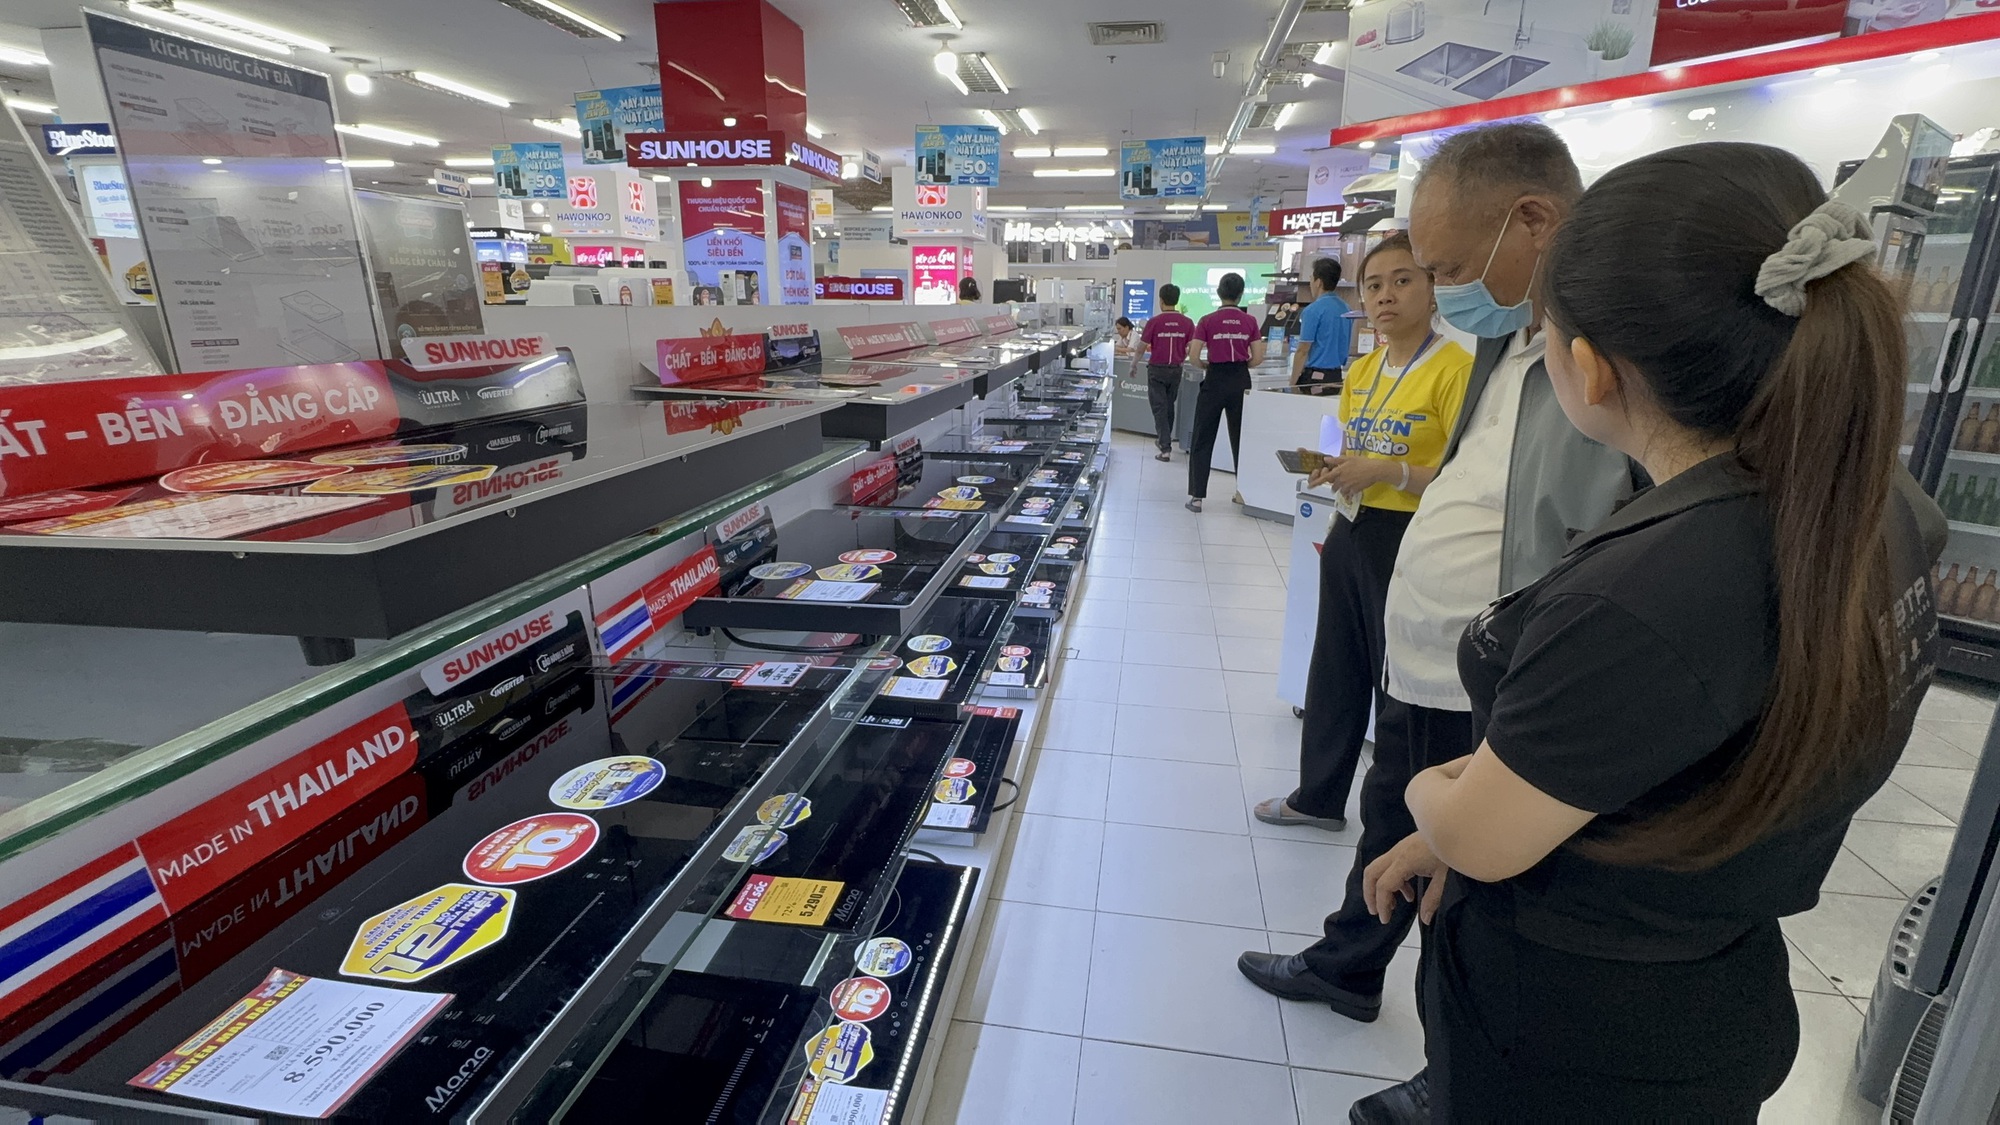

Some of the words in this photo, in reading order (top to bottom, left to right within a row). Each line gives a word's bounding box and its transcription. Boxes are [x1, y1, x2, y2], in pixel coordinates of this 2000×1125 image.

[149, 37, 190, 62] KÍCH
[191, 49, 243, 75] THƯỚC
[244, 60, 271, 82] CẮT
[273, 69, 293, 87] ĐÁ
[640, 140, 771, 160] SUNHOUSE
[791, 141, 839, 177] SUNHOUSE
[557, 213, 611, 222] HAWONKOO
[901, 211, 963, 220] HAWONKOO
[724, 236, 743, 246] KHỐI
[1004, 221, 1104, 243] Hisense
[707, 247, 725, 257] SIÊU
[773, 323, 809, 337] SUNHOUSE
[424, 336, 542, 365] SUNHOUSE
[664, 347, 692, 370] CHẤT
[700, 346, 717, 366] BỀN
[724, 341, 746, 363] ĐẲNG
[747, 341, 762, 359] CẤP
[420, 390, 460, 406] ULTRA
[481, 388, 513, 399] INVERTER
[99, 398, 183, 447] BỀN
[219, 383, 319, 432] ĐẲNG
[324, 379, 380, 416] CẤP
[1372, 415, 1412, 437] LỚN
[723, 505, 760, 538] SUNHOUSE
[648, 598, 668, 616] MADE
[665, 592, 675, 604] IN
[670, 555, 716, 599] THAILAND
[443, 613, 553, 683] SUNHOUSE
[494, 674, 525, 698] INVERTER
[436, 699, 475, 726] ULTRA
[158, 833, 229, 885] MADE
[233, 819, 254, 844] IN
[248, 726, 406, 828] THAILAND
[479, 843, 511, 869] GIẢM
[450, 891, 500, 929] TRIỆU
[743, 897, 756, 912] GIÁ
[753, 881, 768, 898] SỐC
[363, 921, 413, 960] CHƯƠNG
[409, 895, 447, 922] TRÌNH
[370, 923, 461, 974] 12
[153, 1043, 218, 1090] KHUYẾN
[215, 1021, 248, 1043] MÃI
[245, 998, 277, 1021] ĐẶC
[274, 975, 307, 998] BIỆT
[284, 1002, 385, 1084] 8.590.000
[820, 1048, 851, 1081] 12
